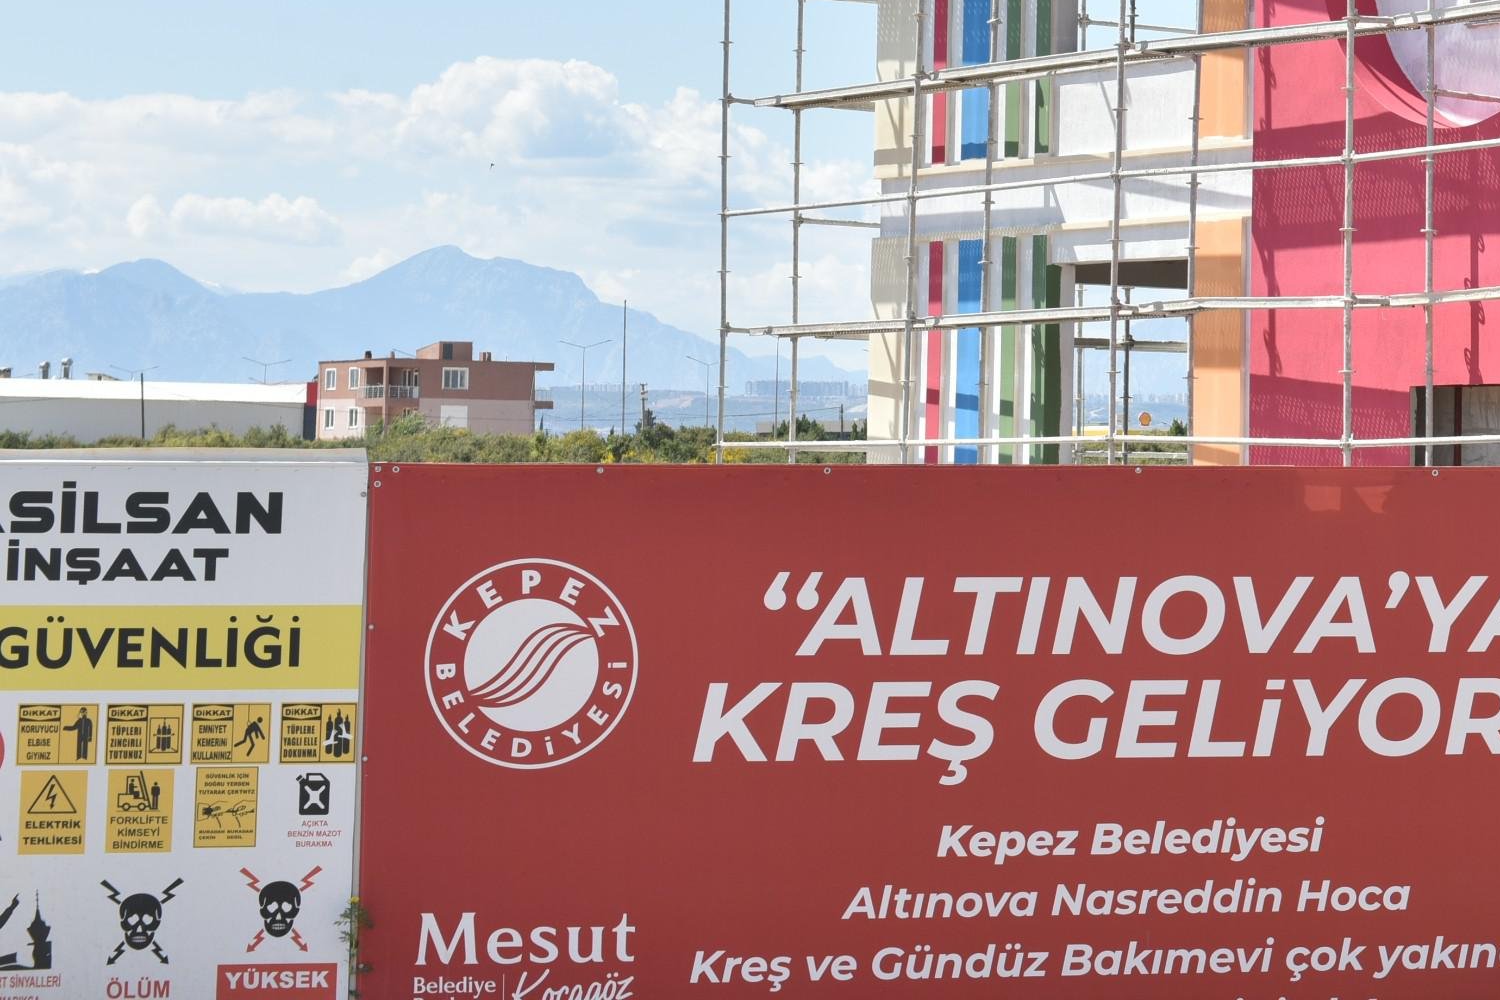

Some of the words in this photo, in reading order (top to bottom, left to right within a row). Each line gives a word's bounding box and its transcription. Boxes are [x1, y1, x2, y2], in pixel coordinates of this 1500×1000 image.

[7, 539, 229, 585] İNŞAAT
[443, 569, 620, 641] KEPEZ
[0, 614, 301, 669] GÜVENLİĞİ
[436, 661, 627, 758] BELEDİYESİ
[21, 725, 59, 734] KORUYUCU
[692, 680, 1000, 786] KREŞ
[304, 736, 319, 746] ELLE
[109, 750, 143, 760] TUTUNUZ
[283, 748, 317, 758] DOKUNMA
[25, 819, 81, 829] ELEKTRİK
[110, 815, 168, 825] FORKLİFTE
[301, 820, 328, 829] AÇIKTA
[22, 835, 82, 846] TEHLİKESİ
[117, 827, 160, 837] KİMSEYİ
[287, 829, 314, 838] BENZİN
[315, 830, 342, 838] MAZOT
[936, 824, 1079, 866] Kepez
[1090, 815, 1325, 862] Belediyesi
[112, 839, 164, 849] BİNDİRME
[841, 884, 1038, 920] Altınova
[1051, 877, 1283, 917] Nasreddin
[1296, 879, 1411, 913] Hoca
[415, 912, 636, 966] Mesut
[689, 950, 792, 991] Kreş
[806, 955, 857, 982] ve
[871, 942, 1049, 981] Gündüz
[1061, 936, 1276, 978] Bakımevi
[1285, 937, 1367, 983] çok
[106, 977, 170, 999] ÖLÜM
[225, 967, 329, 990] YÜKSEK
[413, 976, 497, 1000] Belediye
